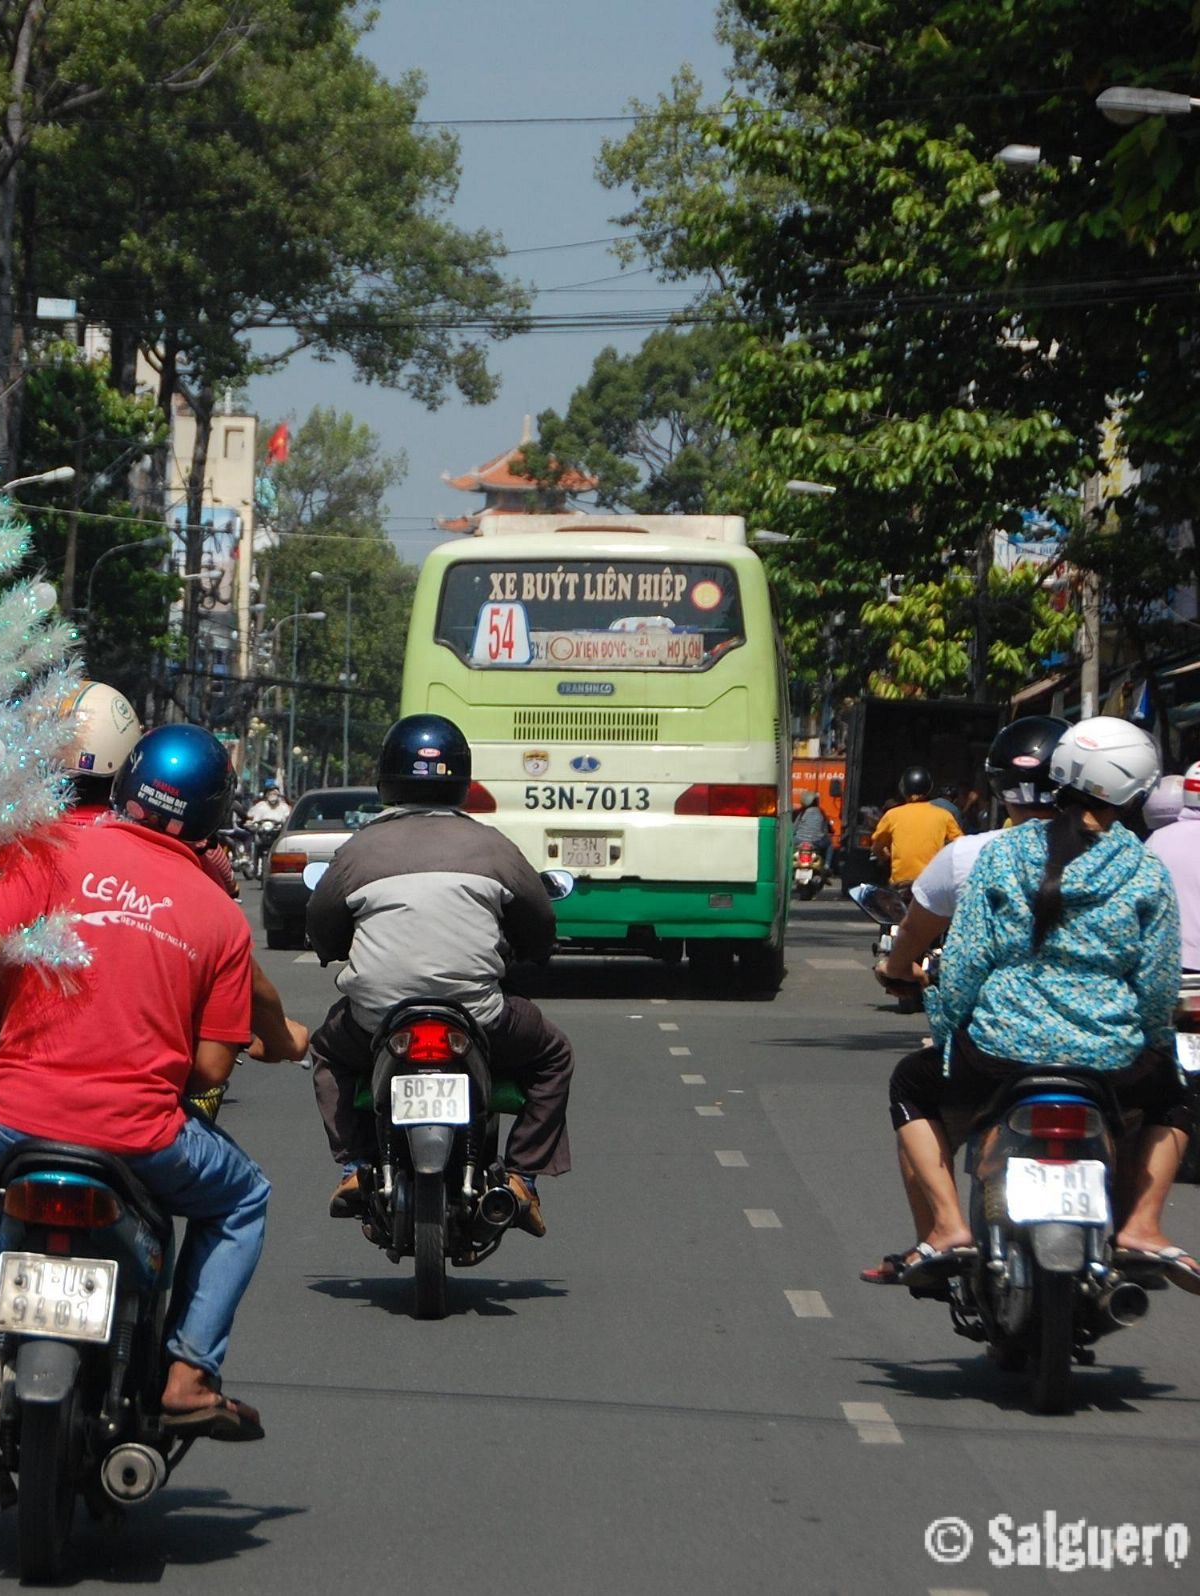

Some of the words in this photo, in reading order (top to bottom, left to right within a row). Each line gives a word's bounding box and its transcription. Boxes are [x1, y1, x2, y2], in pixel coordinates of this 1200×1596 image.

[489, 572, 518, 601] XE
[522, 565, 579, 601] BUÝT
[583, 566, 632, 601] LIÊN
[637, 567, 687, 608] HIỆP
[488, 607, 514, 660] 54
[525, 786, 650, 811] 53N-7013
[571, 839, 598, 851] 53N
[567, 852, 601, 865] 7013
